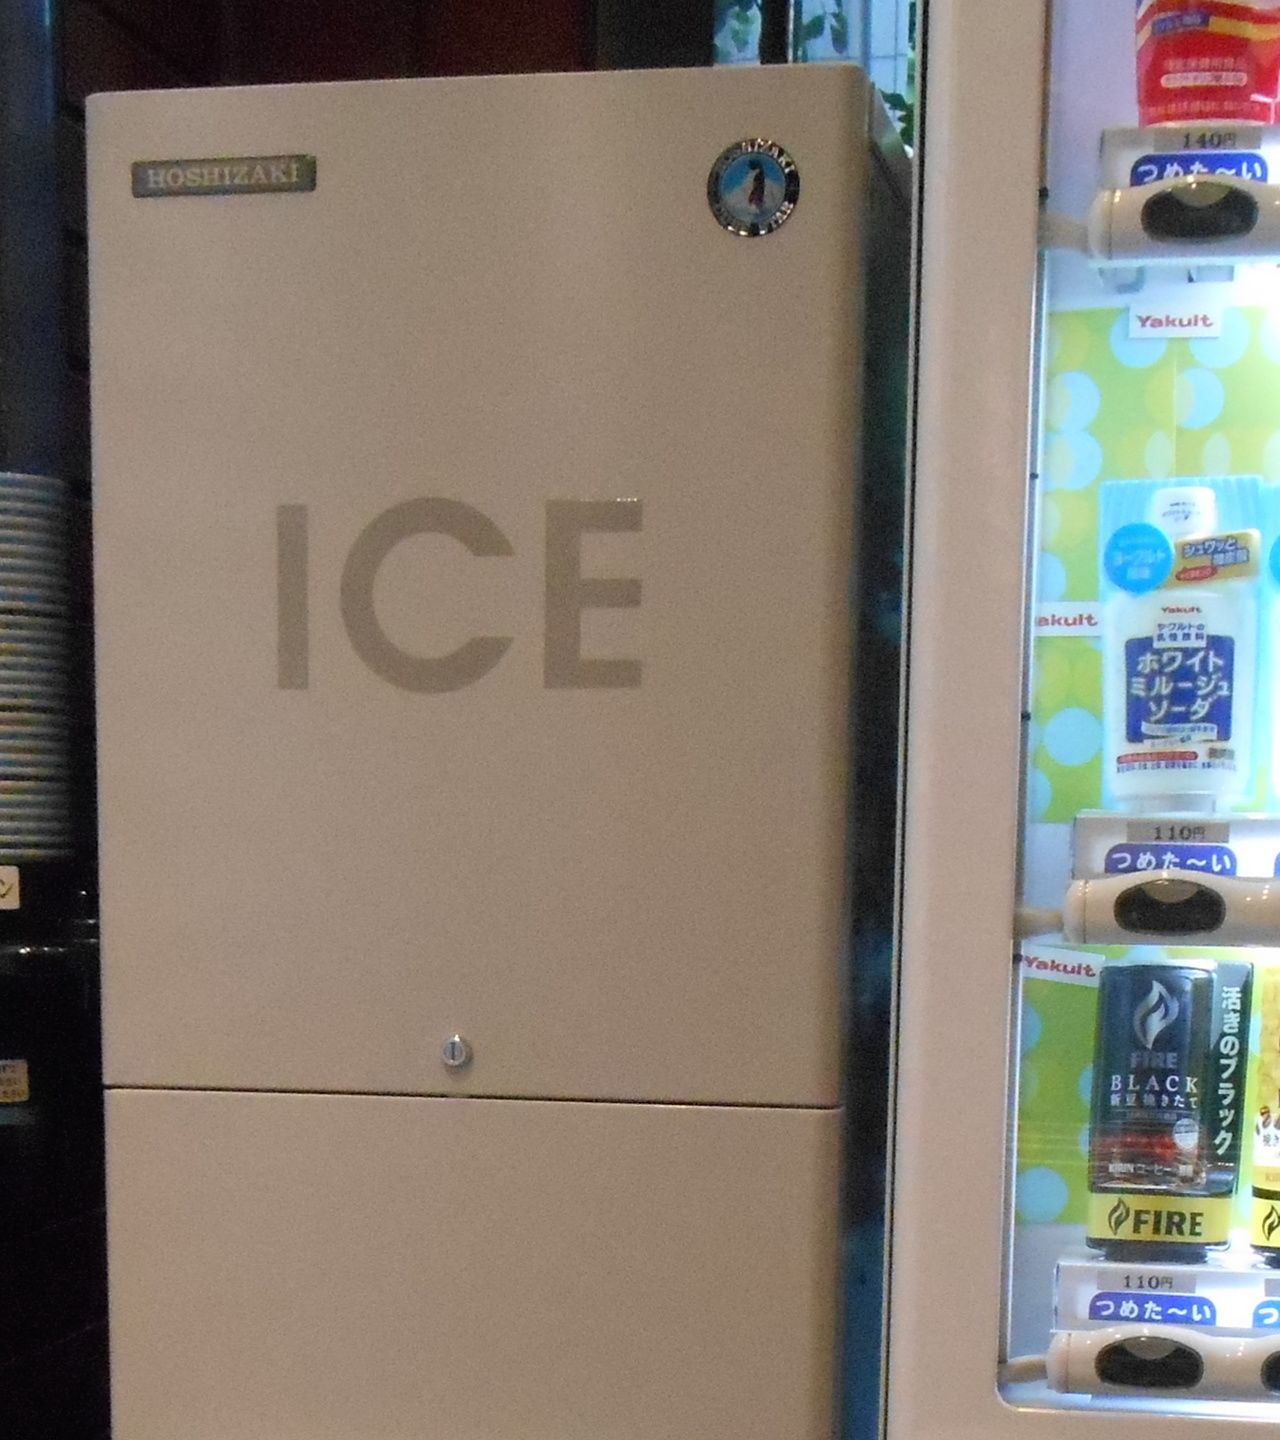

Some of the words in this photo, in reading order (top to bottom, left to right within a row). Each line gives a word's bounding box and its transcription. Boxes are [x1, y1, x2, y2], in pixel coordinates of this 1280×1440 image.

[147, 162, 300, 189] HOSHIZAKI
[1136, 314, 1214, 329] Yakult
[276, 496, 644, 695] ICE
[1037, 613, 1099, 628] akult
[1161, 606, 1202, 615] Yakult
[1137, 650, 1224, 675] ホワイト
[1130, 676, 1231, 697] ミルージュ
[1149, 696, 1212, 723] ソーダ
[1025, 956, 1097, 978] Yakult
[1129, 1051, 1178, 1069] FIRE
[1110, 1074, 1199, 1092] BLACK
[1132, 1208, 1205, 1237] FIRE
[1124, 1274, 1174, 1290] 110円
